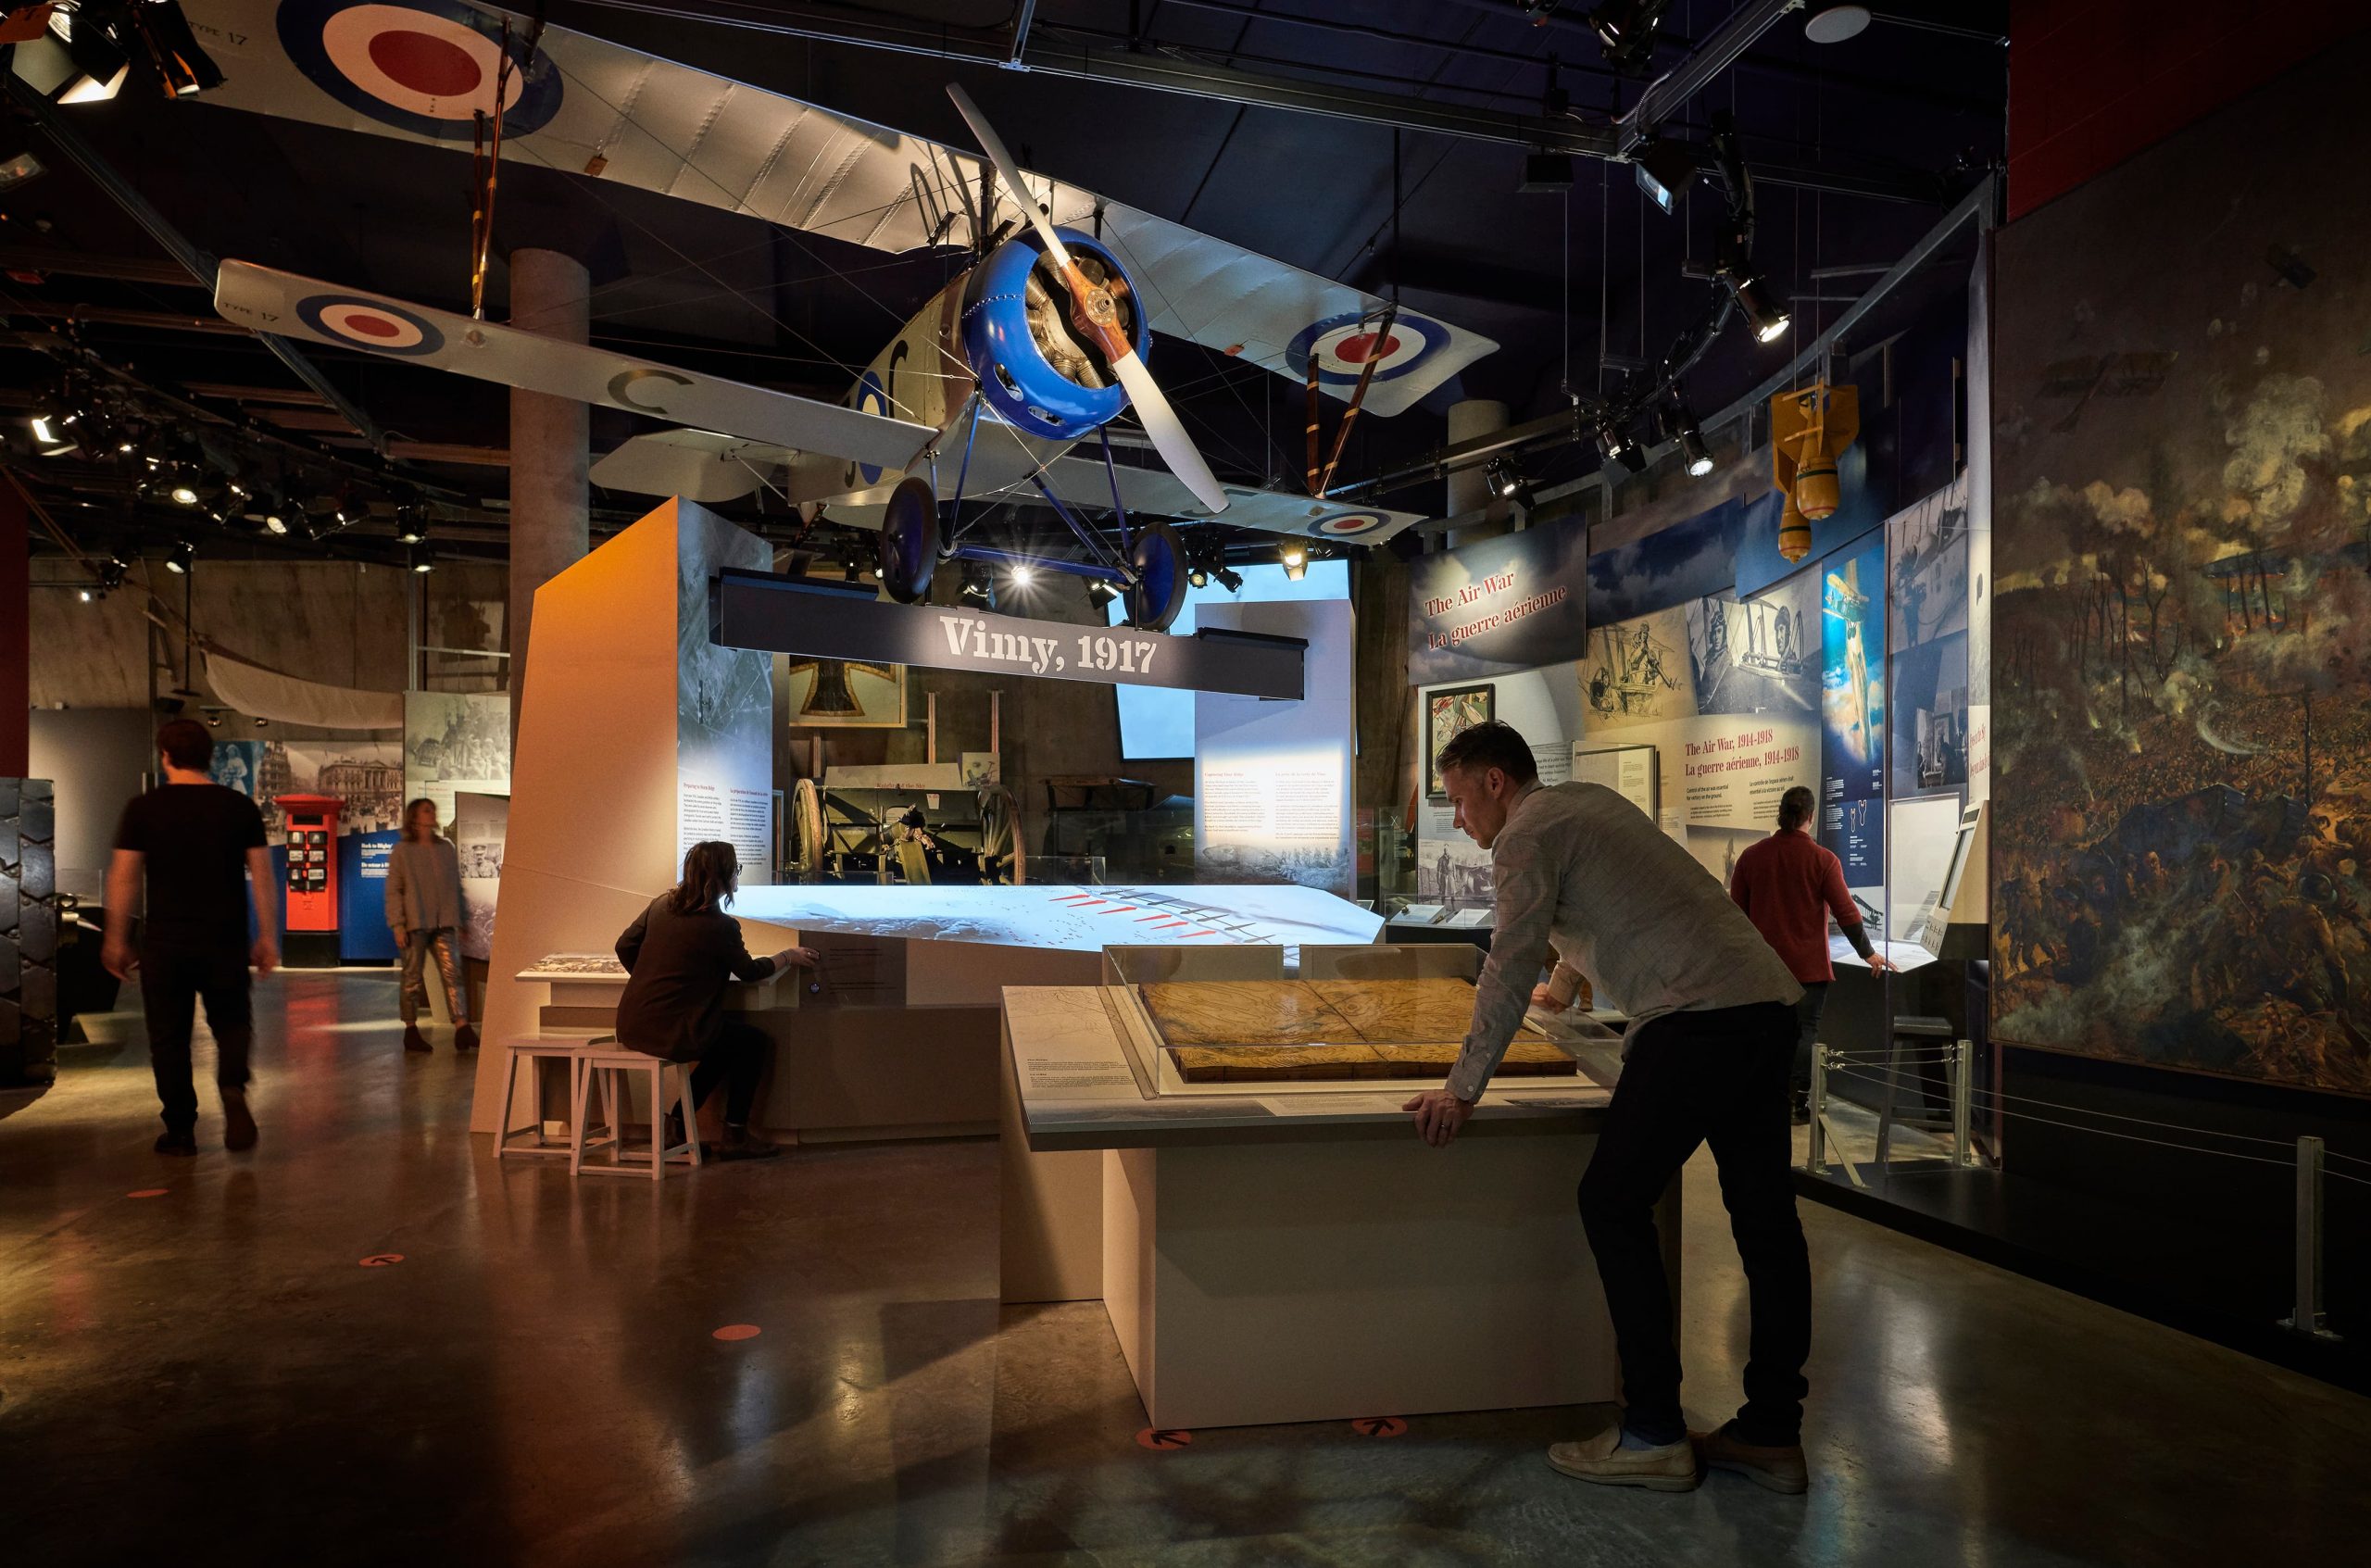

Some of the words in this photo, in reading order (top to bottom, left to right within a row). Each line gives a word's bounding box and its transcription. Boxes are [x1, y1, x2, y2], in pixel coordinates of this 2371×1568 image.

[608, 369, 694, 414] C
[1424, 597, 1453, 617] The
[1458, 585, 1481, 607] Air
[1484, 572, 1514, 595] War
[1428, 633, 1448, 650] La
[1451, 614, 1499, 646] guerre
[1504, 586, 1566, 623] aérienne
[939, 615, 1065, 674] Vimy,
[1077, 634, 1157, 673] 1917
[1686, 742, 1700, 756] The
[1702, 739, 1715, 754] Air
[1717, 737, 1735, 752] War,
[1737, 728, 1773, 748] 1914-1918
[1686, 763, 1695, 776] La
[1697, 760, 1724, 778] guerre
[1725, 756, 1762, 771] aérienne,
[1764, 746, 1800, 765] 1914-1918
